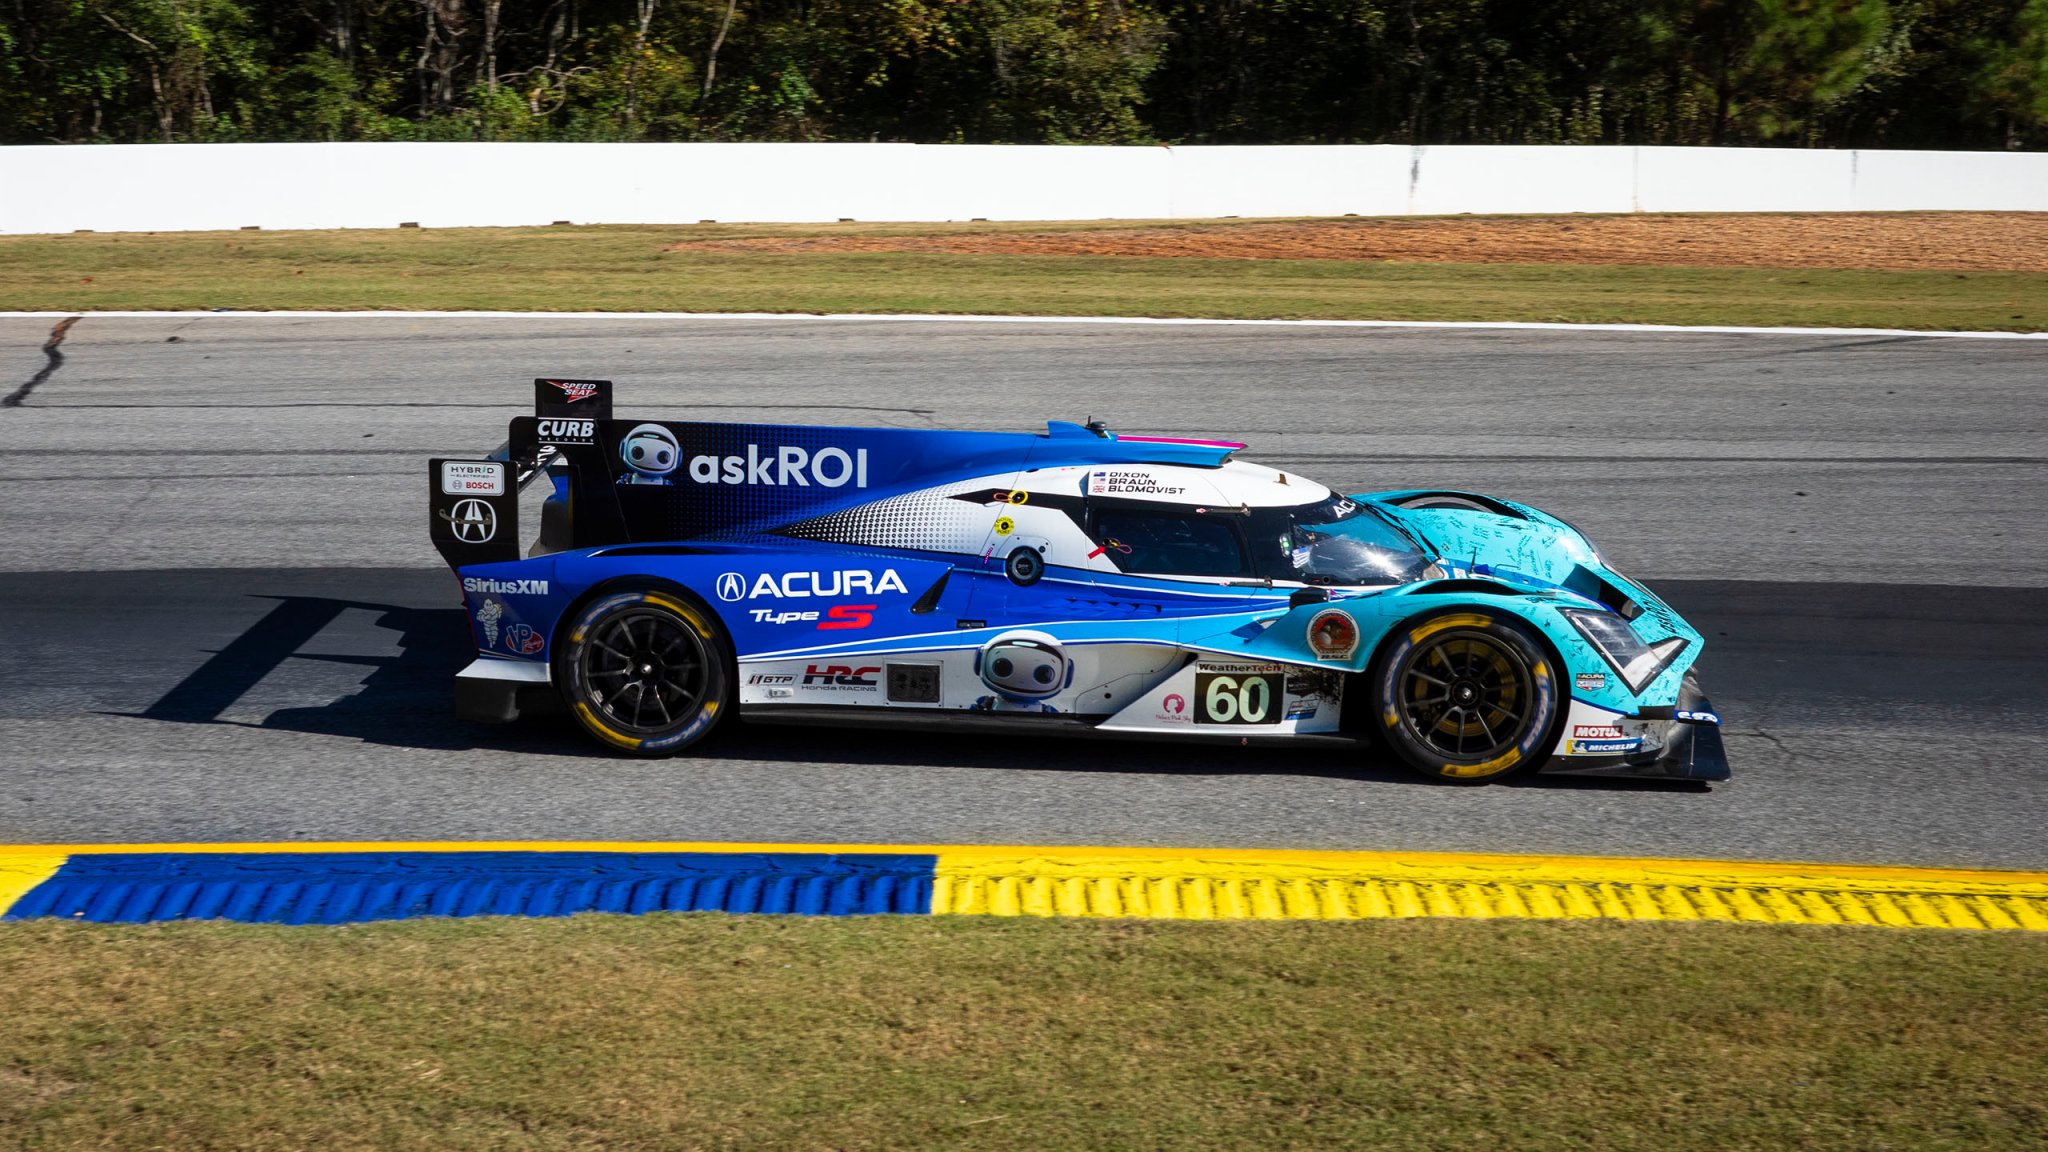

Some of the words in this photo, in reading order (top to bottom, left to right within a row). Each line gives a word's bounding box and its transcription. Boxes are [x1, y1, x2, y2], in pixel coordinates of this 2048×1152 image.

[562, 382, 597, 390] SPEED
[537, 420, 595, 437] CURB
[689, 444, 868, 489] askROI
[1109, 471, 1150, 479] DIXON
[465, 482, 495, 490] BOSCH
[1108, 478, 1157, 486] BRAUN
[1107, 485, 1186, 495] BLOMQVIST
[463, 577, 549, 595] SiriusXM
[748, 568, 909, 599] ACURA
[749, 609, 820, 625] Type
[816, 604, 878, 631] S
[1198, 663, 1282, 672] WeatherTech
[763, 675, 794, 684] GTP
[801, 665, 882, 685] HRC
[1206, 676, 1270, 723] 60
[1575, 727, 1621, 737] MOTUL
[1588, 743, 1638, 751] MICHELIN
